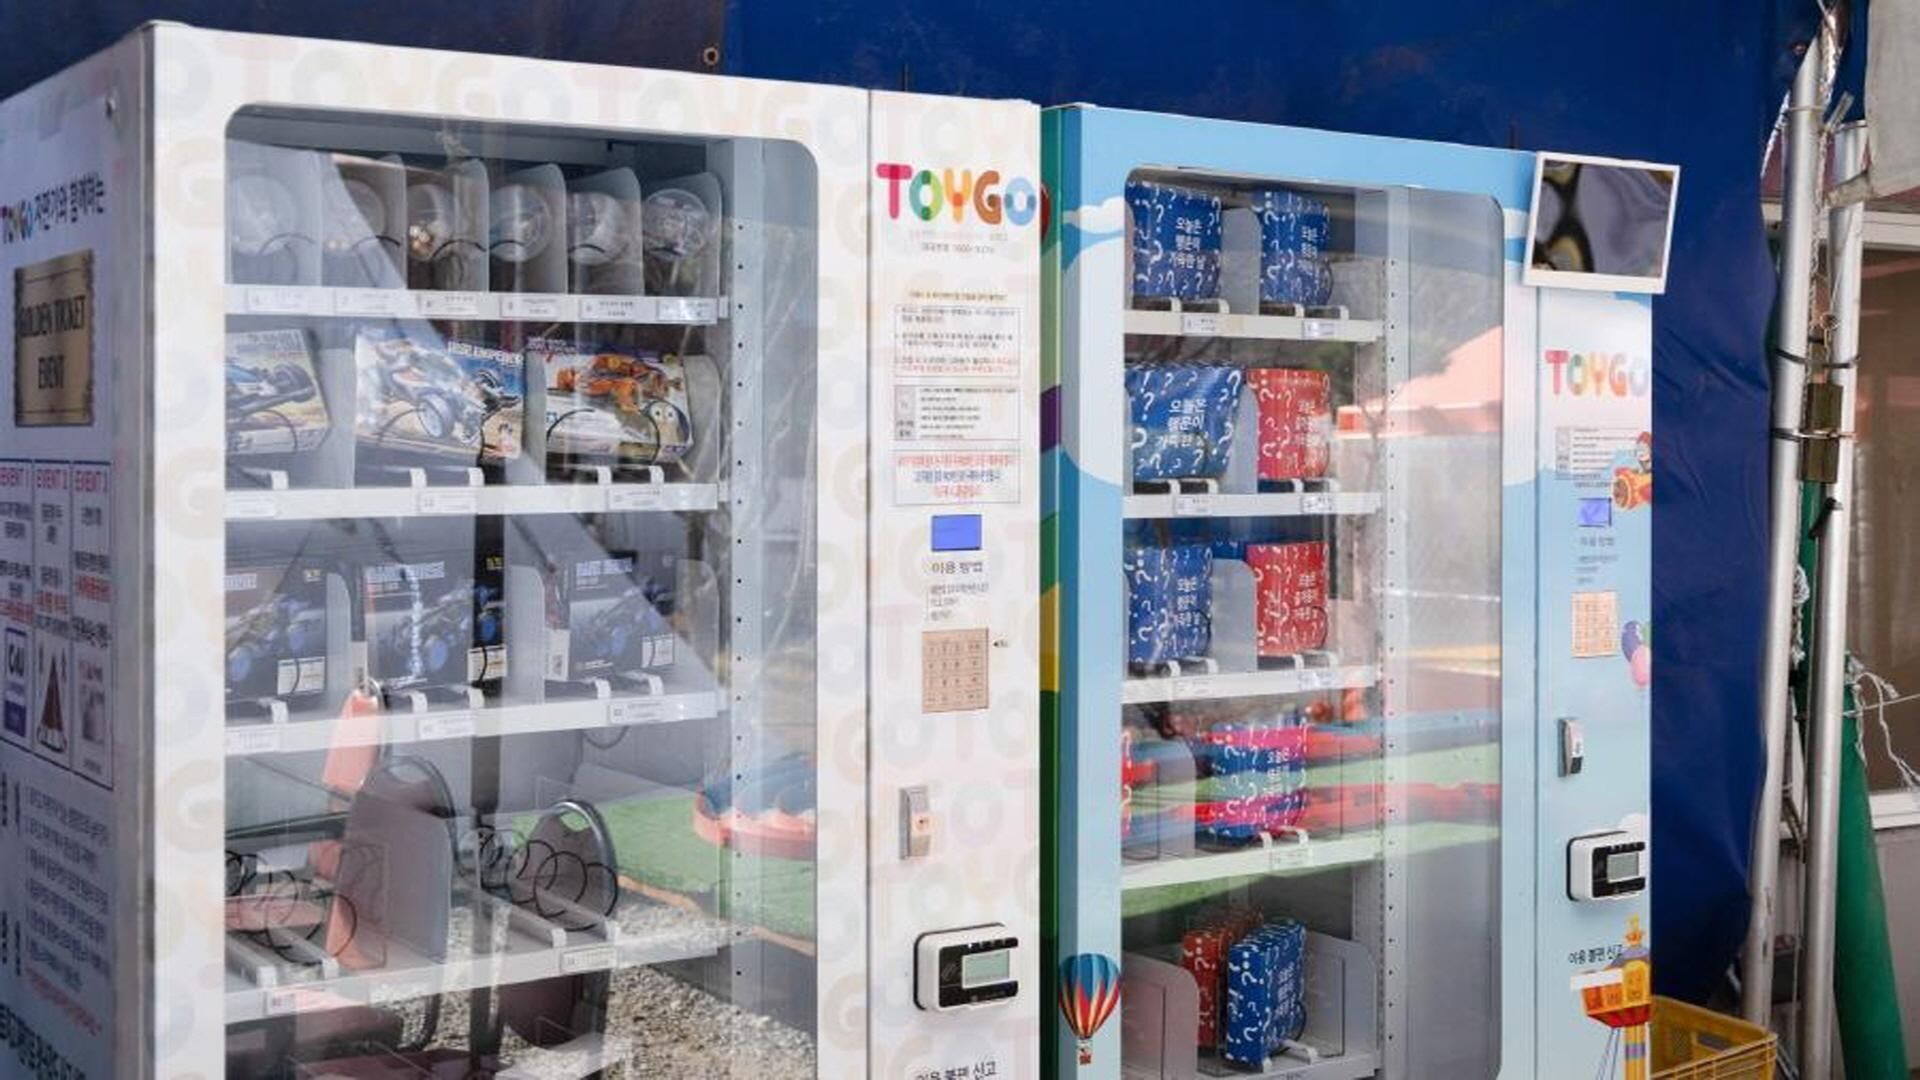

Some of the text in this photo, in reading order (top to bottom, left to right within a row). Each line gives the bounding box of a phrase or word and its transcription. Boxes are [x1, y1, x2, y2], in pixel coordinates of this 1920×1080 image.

[876, 163, 1037, 226] TOYGO
[1176, 217, 1203, 235] 오늘은
[19, 295, 87, 339] GOLDEN TICKET
[37, 354, 65, 391] EVENT
[1545, 349, 1650, 397] TOYGO
[1167, 397, 1208, 414] 오늘은
[1167, 414, 1206, 432] 행운이
[931, 560, 984, 576] 이용 방법
[1567, 943, 1623, 966] 이용 불편 신고
[973, 1060, 997, 1080] 신고
